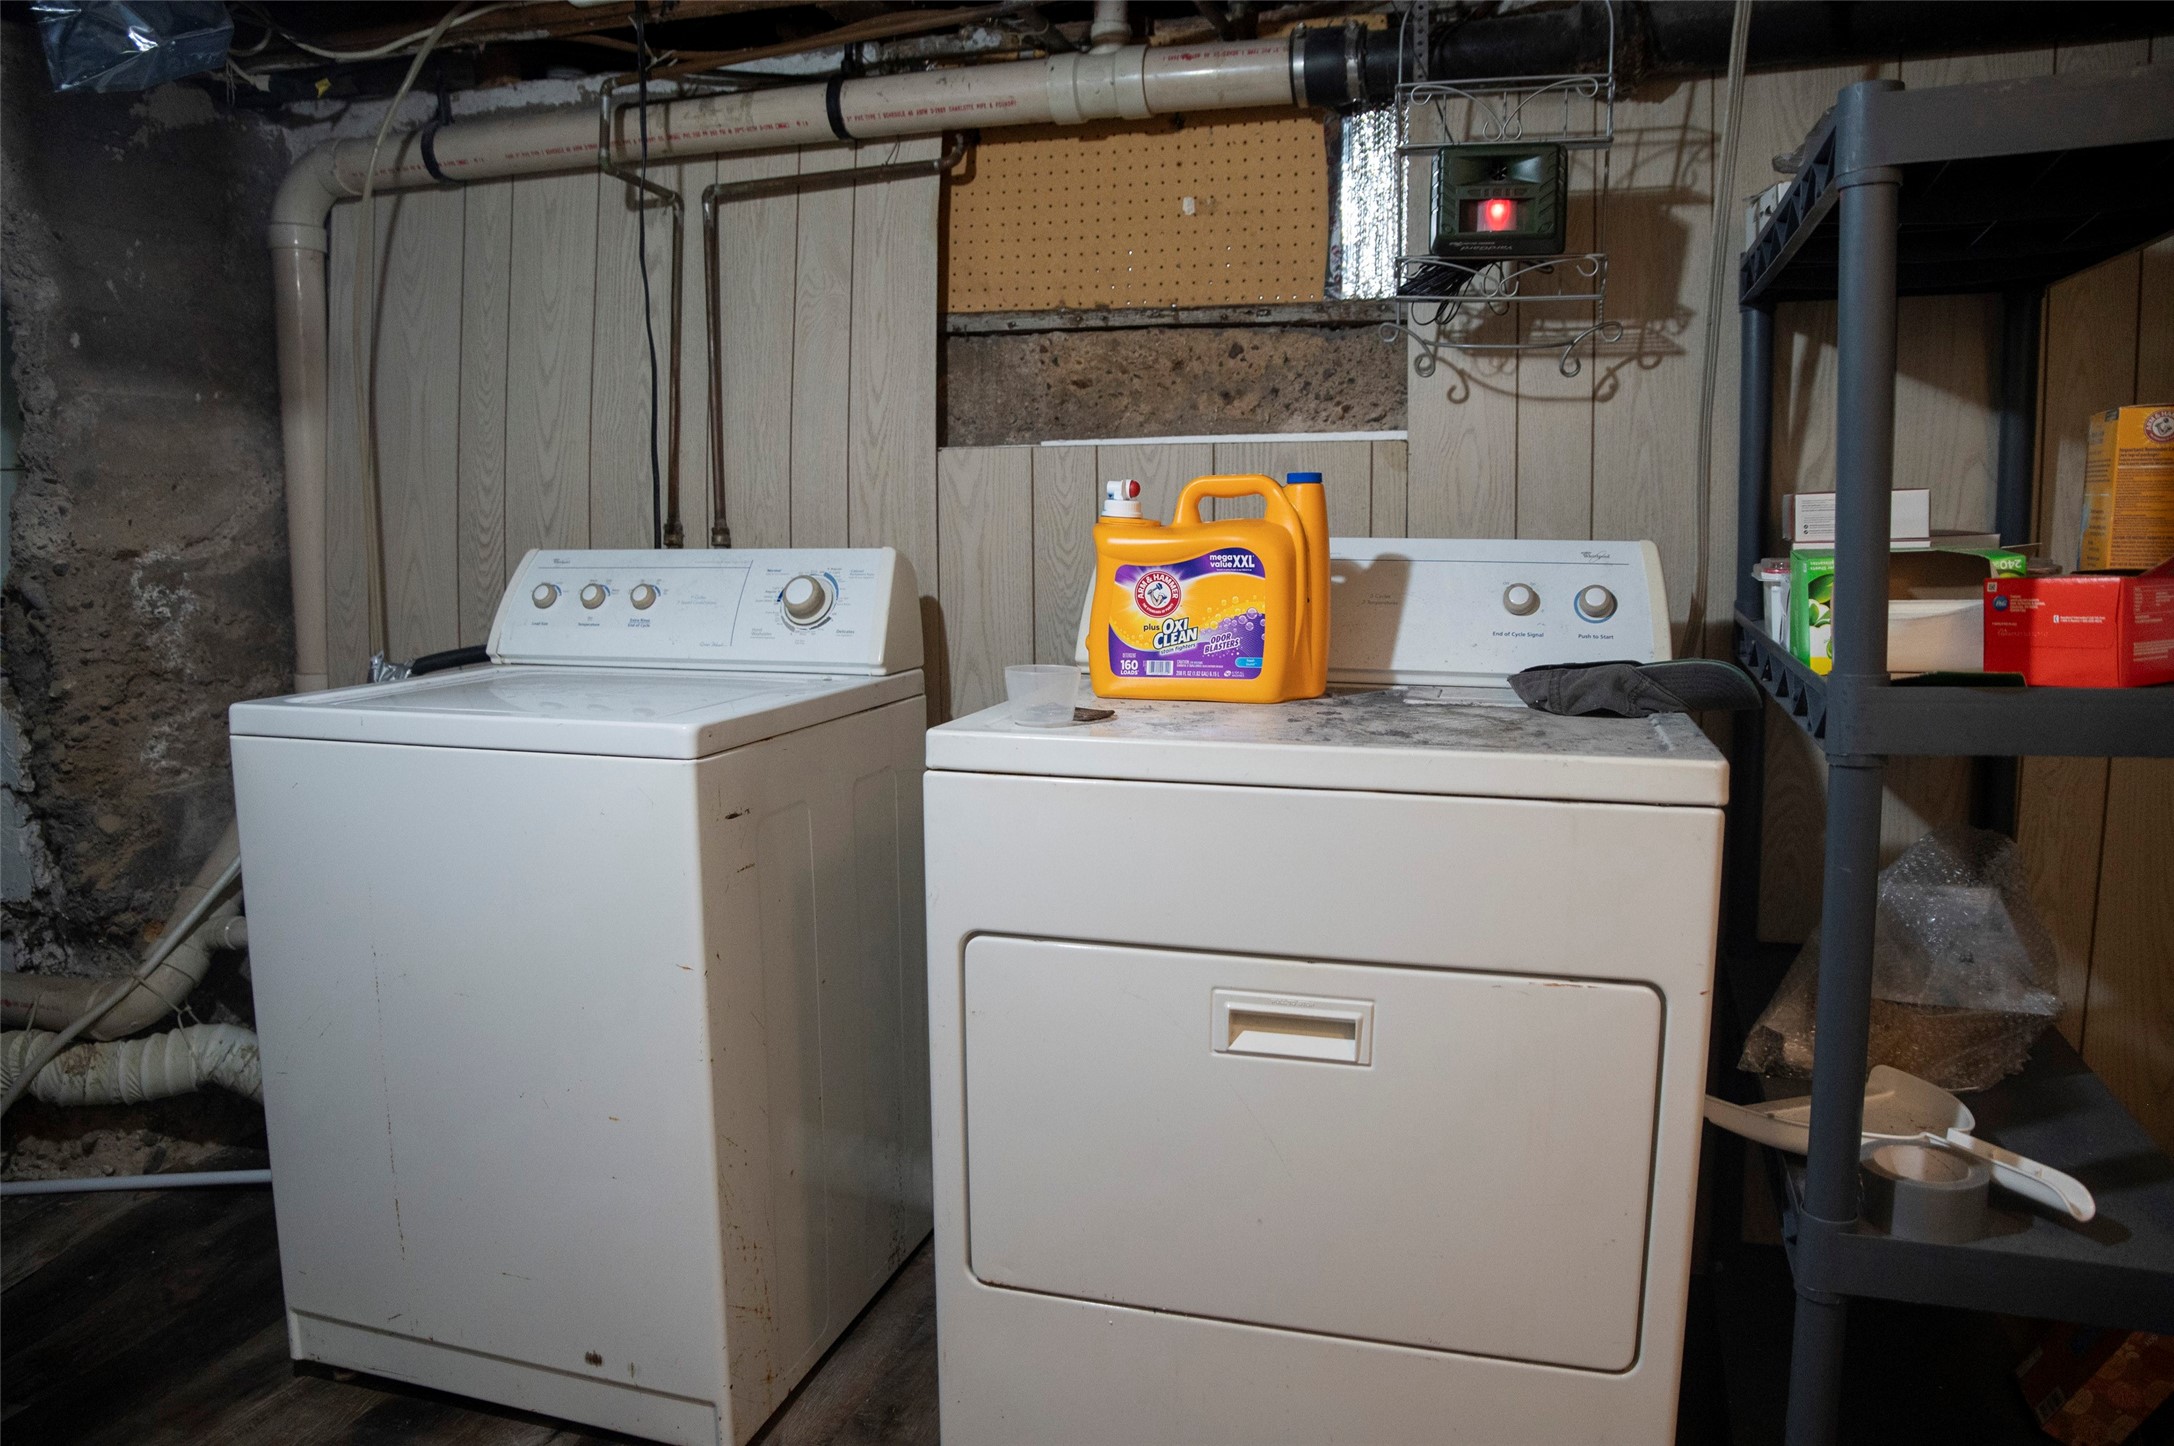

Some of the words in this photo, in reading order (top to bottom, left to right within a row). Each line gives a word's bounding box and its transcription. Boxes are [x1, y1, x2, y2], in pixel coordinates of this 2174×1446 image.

[1210, 560, 1232, 568] value
[1233, 555, 1255, 568] XXL
[1137, 580, 1147, 599] ARM
[1145, 576, 1153, 584] &
[1153, 574, 1178, 599] HAMMER
[1143, 623, 1160, 632] plus
[1162, 617, 1189, 635] OXI
[1153, 627, 1199, 650] CLEAN
[1210, 632, 1232, 644] ODOR
[1204, 638, 1240, 654] BLASTERS
[1120, 659, 1139, 670] 160
